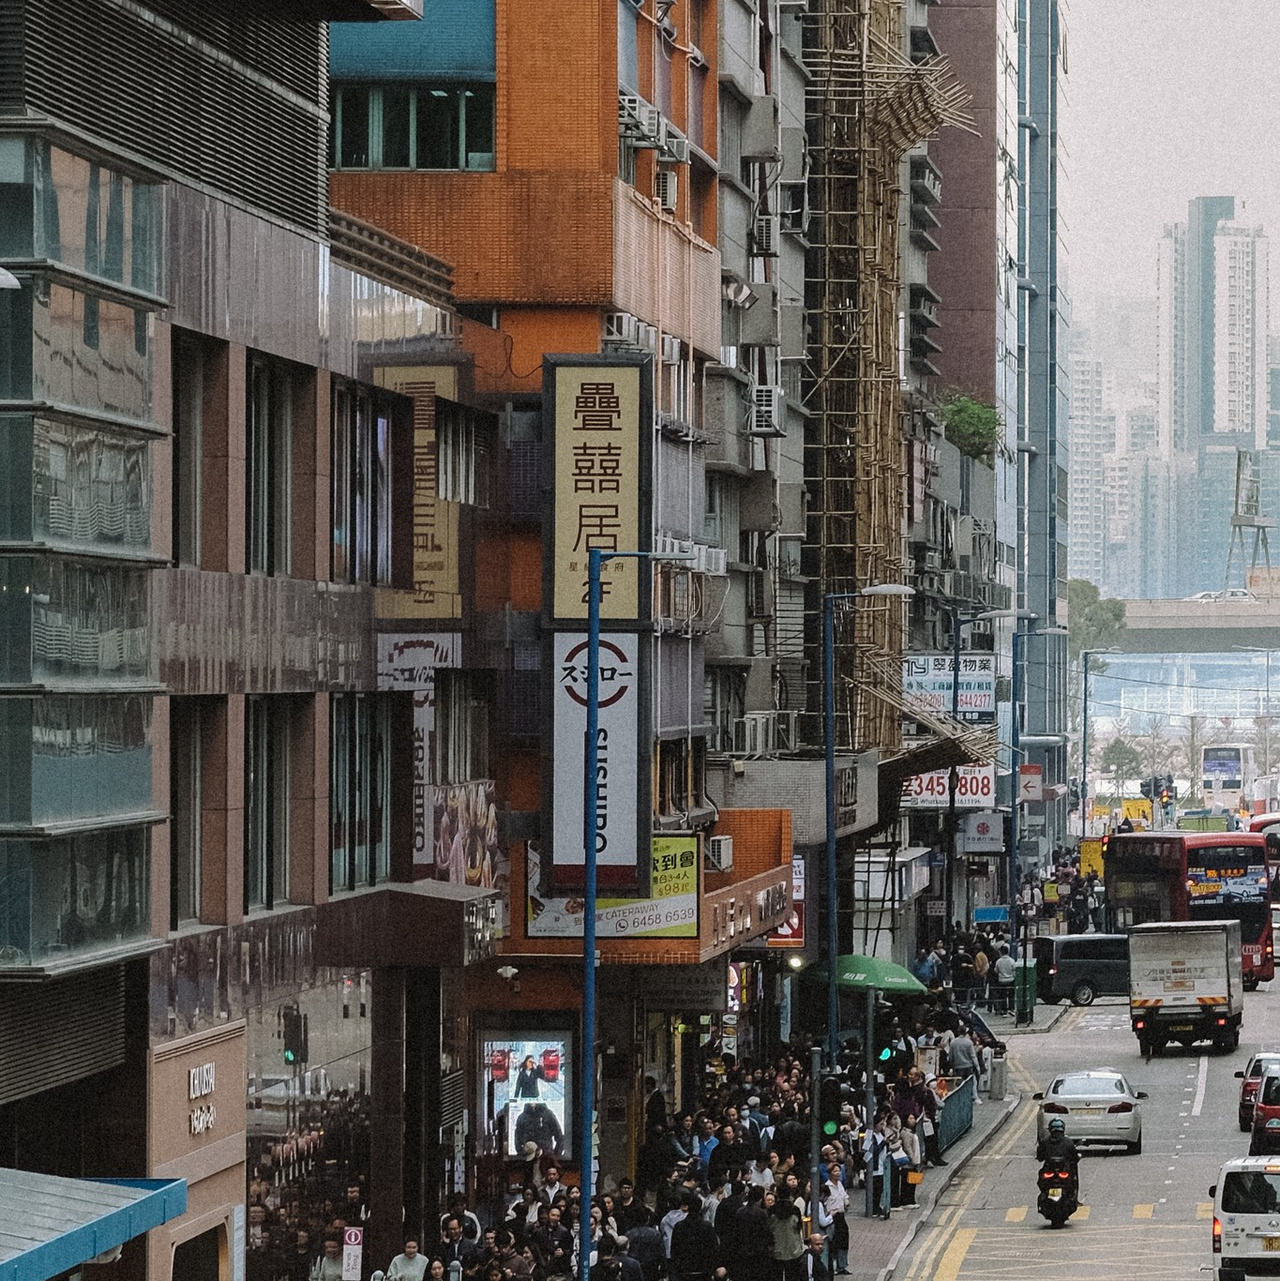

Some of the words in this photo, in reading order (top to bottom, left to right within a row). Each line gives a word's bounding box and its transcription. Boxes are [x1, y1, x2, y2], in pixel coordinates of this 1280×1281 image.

[903, 775, 991, 796] 345808
[605, 904, 661, 921] CATERAWAY
[632, 914, 662, 929] 6458
[666, 907, 695, 923] 6539
